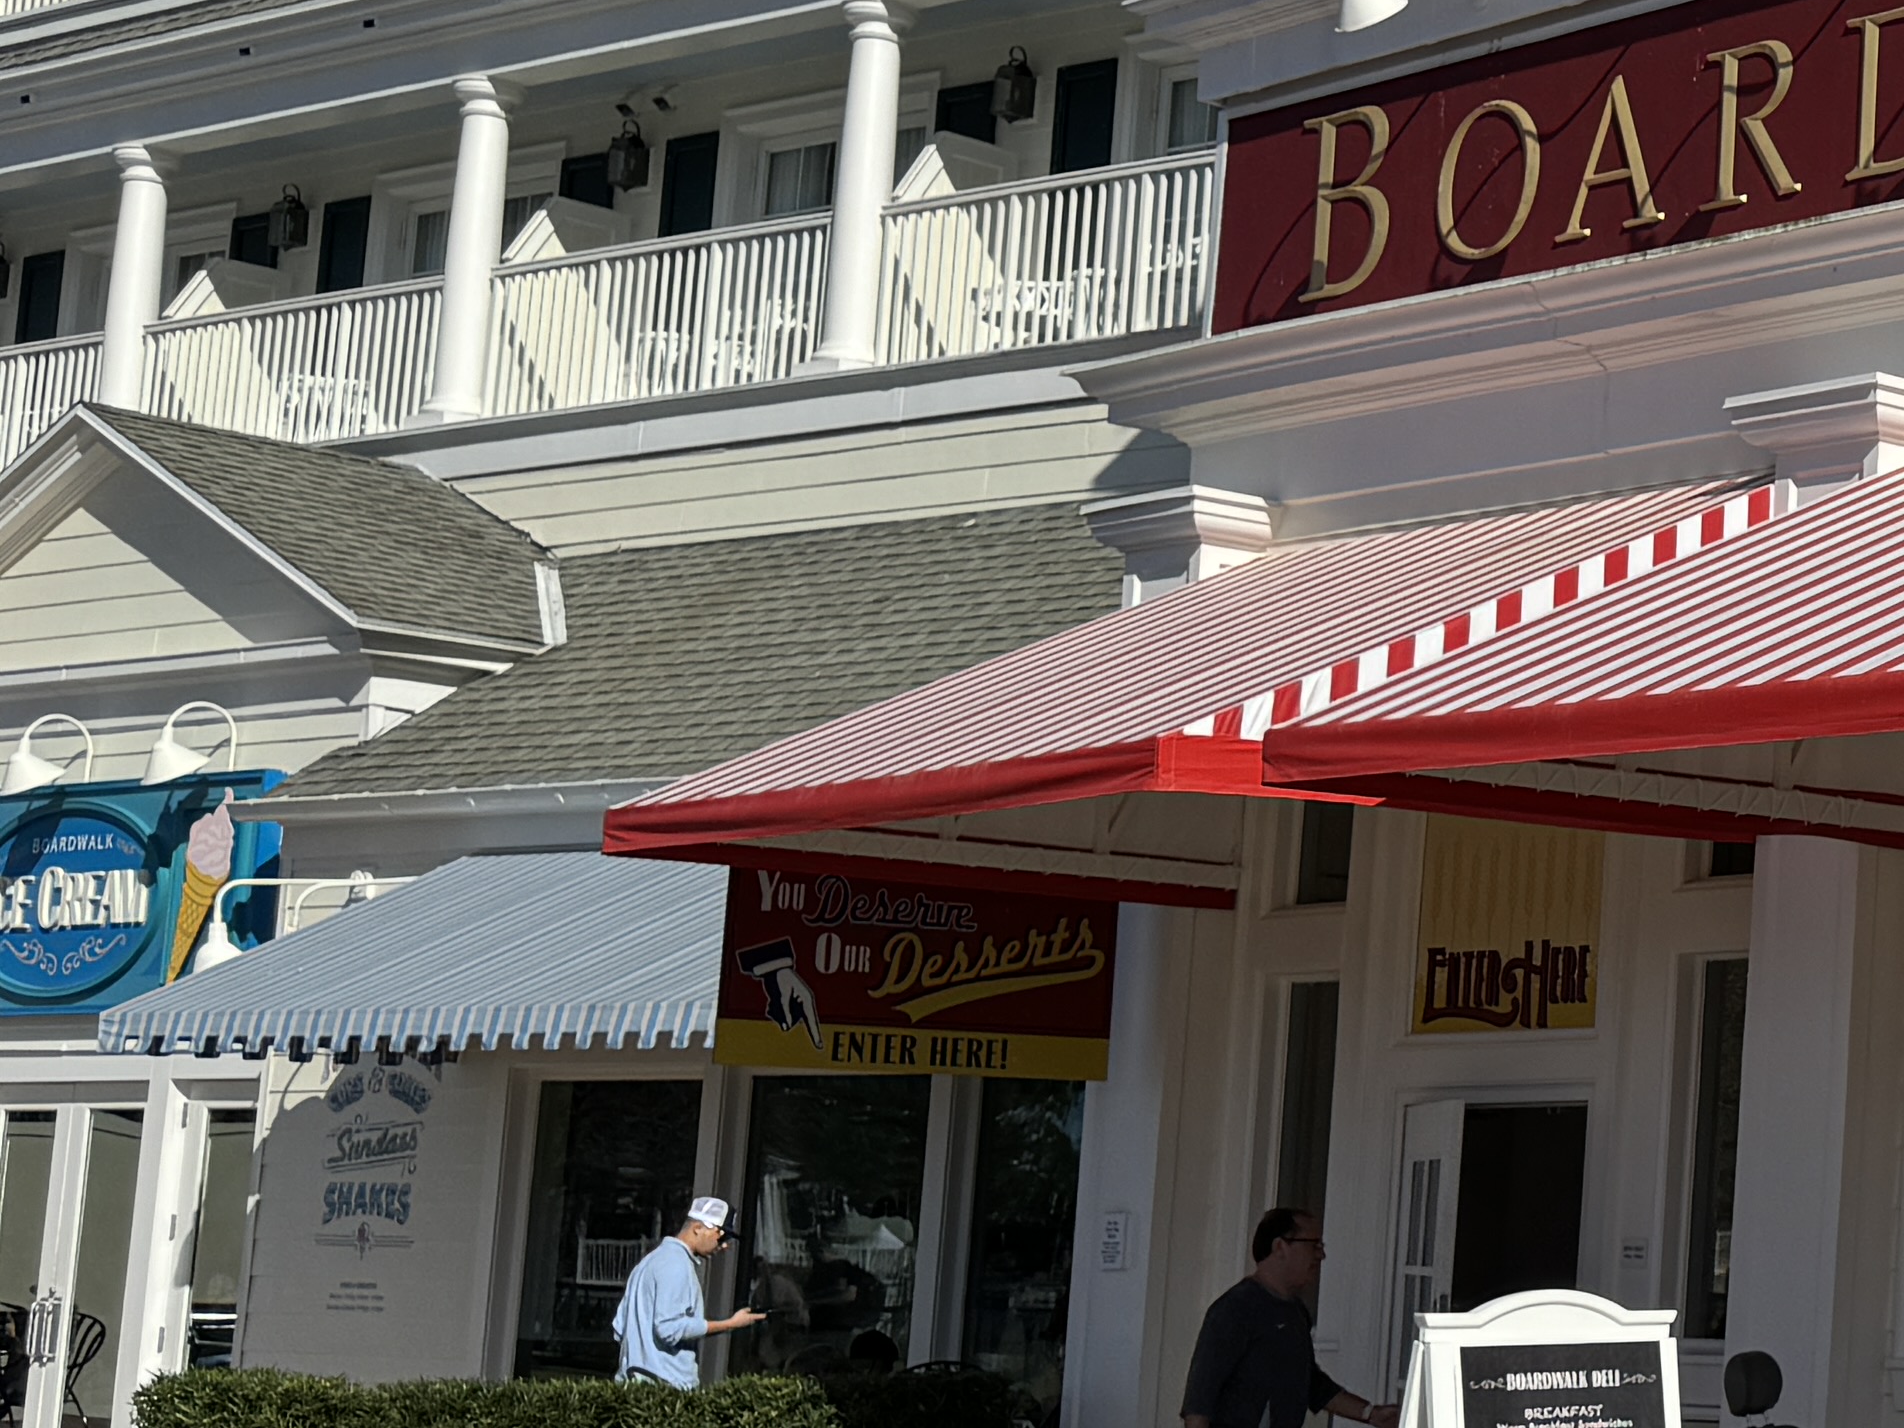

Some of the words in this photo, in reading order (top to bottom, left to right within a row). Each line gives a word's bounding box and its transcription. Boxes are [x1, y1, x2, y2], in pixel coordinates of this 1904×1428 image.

[32, 834, 113, 853] BOARDWALK
[38, 866, 149, 931] CREAM
[757, 870, 805, 912] YOU
[802, 874, 977, 932] Deserve
[815, 933, 871, 973] OUR
[867, 917, 1105, 1000] Desserts
[1421, 947, 1520, 1028] ENTER
[1501, 939, 1590, 1029] HERE
[831, 1031, 916, 1065] ENTER
[930, 1037, 1008, 1070] HERE!
[322, 1182, 411, 1225] SHAKES
[1507, 1371, 1588, 1391] BOARDWALK
[1592, 1369, 1620, 1388] DELI
[1524, 1404, 1603, 1420] BREAKFAST
